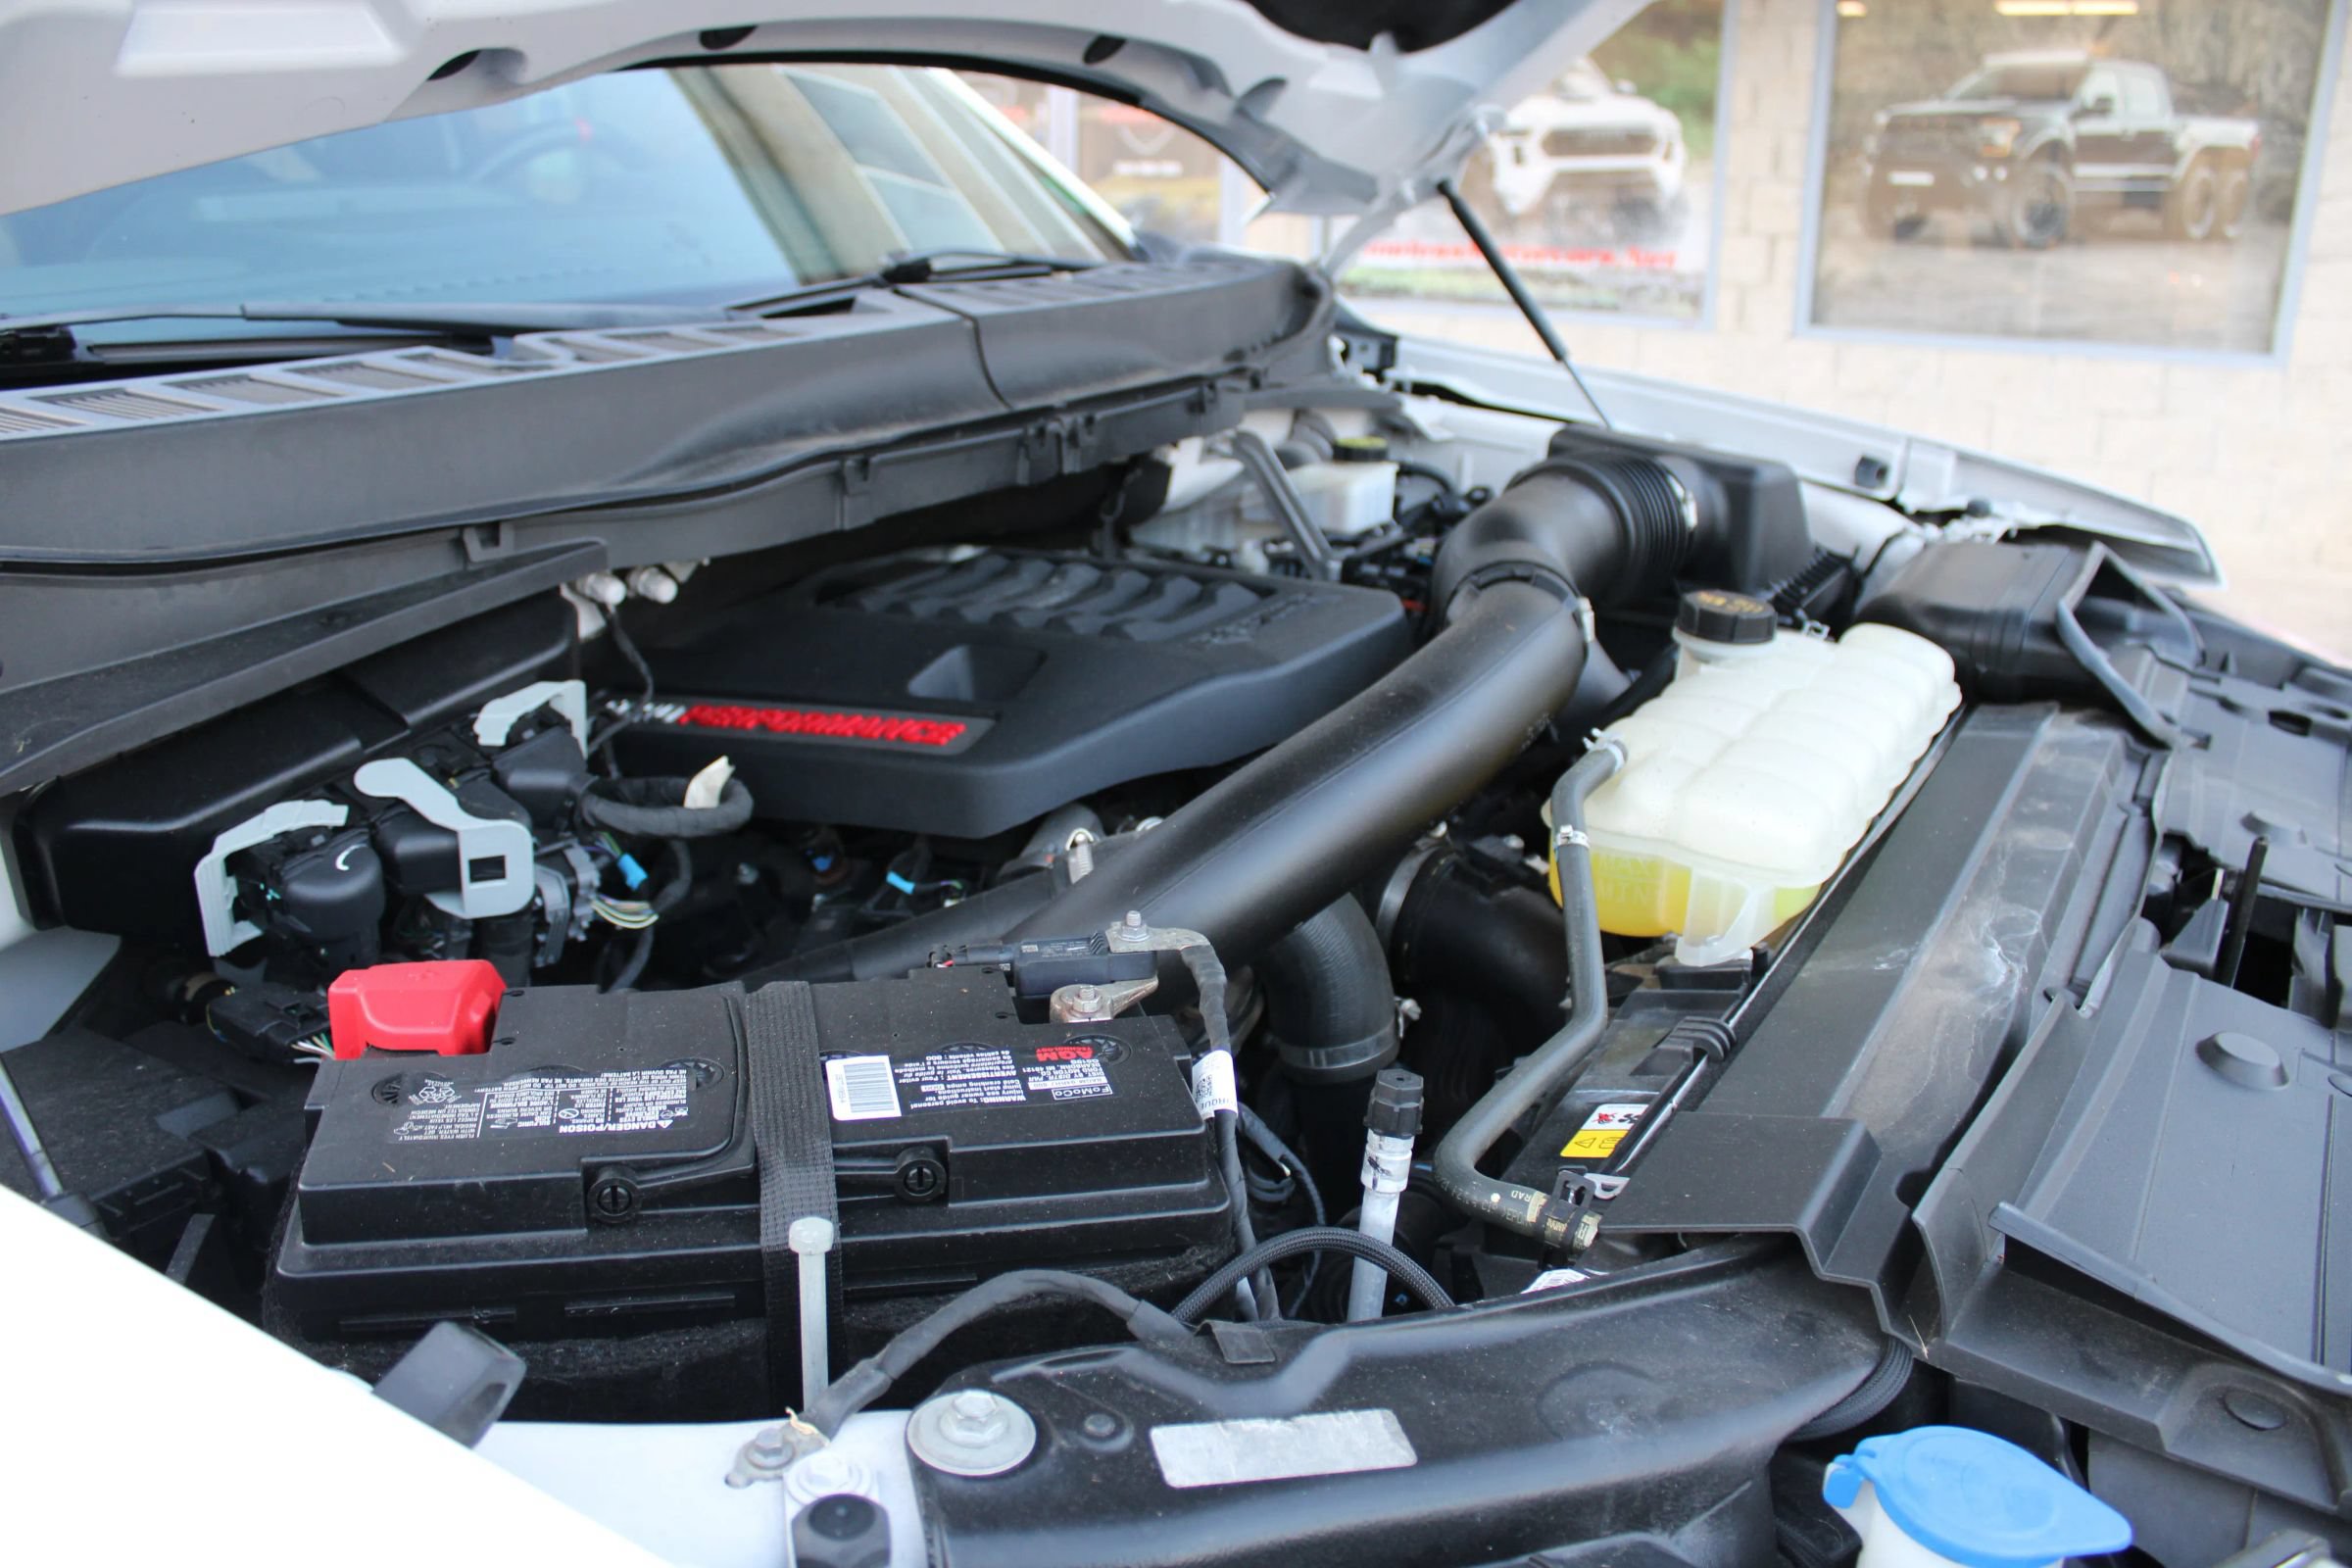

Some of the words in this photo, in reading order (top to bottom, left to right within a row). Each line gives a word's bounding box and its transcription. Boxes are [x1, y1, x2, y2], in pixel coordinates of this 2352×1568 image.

[947, 1070, 1016, 1081] AVERTISSEMENT
[1054, 1086, 1109, 1097] FoMoCo
[980, 1095, 1026, 1103] WARNING:
[560, 1121, 656, 1133] DANGER/POISON
[1511, 1190, 1532, 1202] RAD
